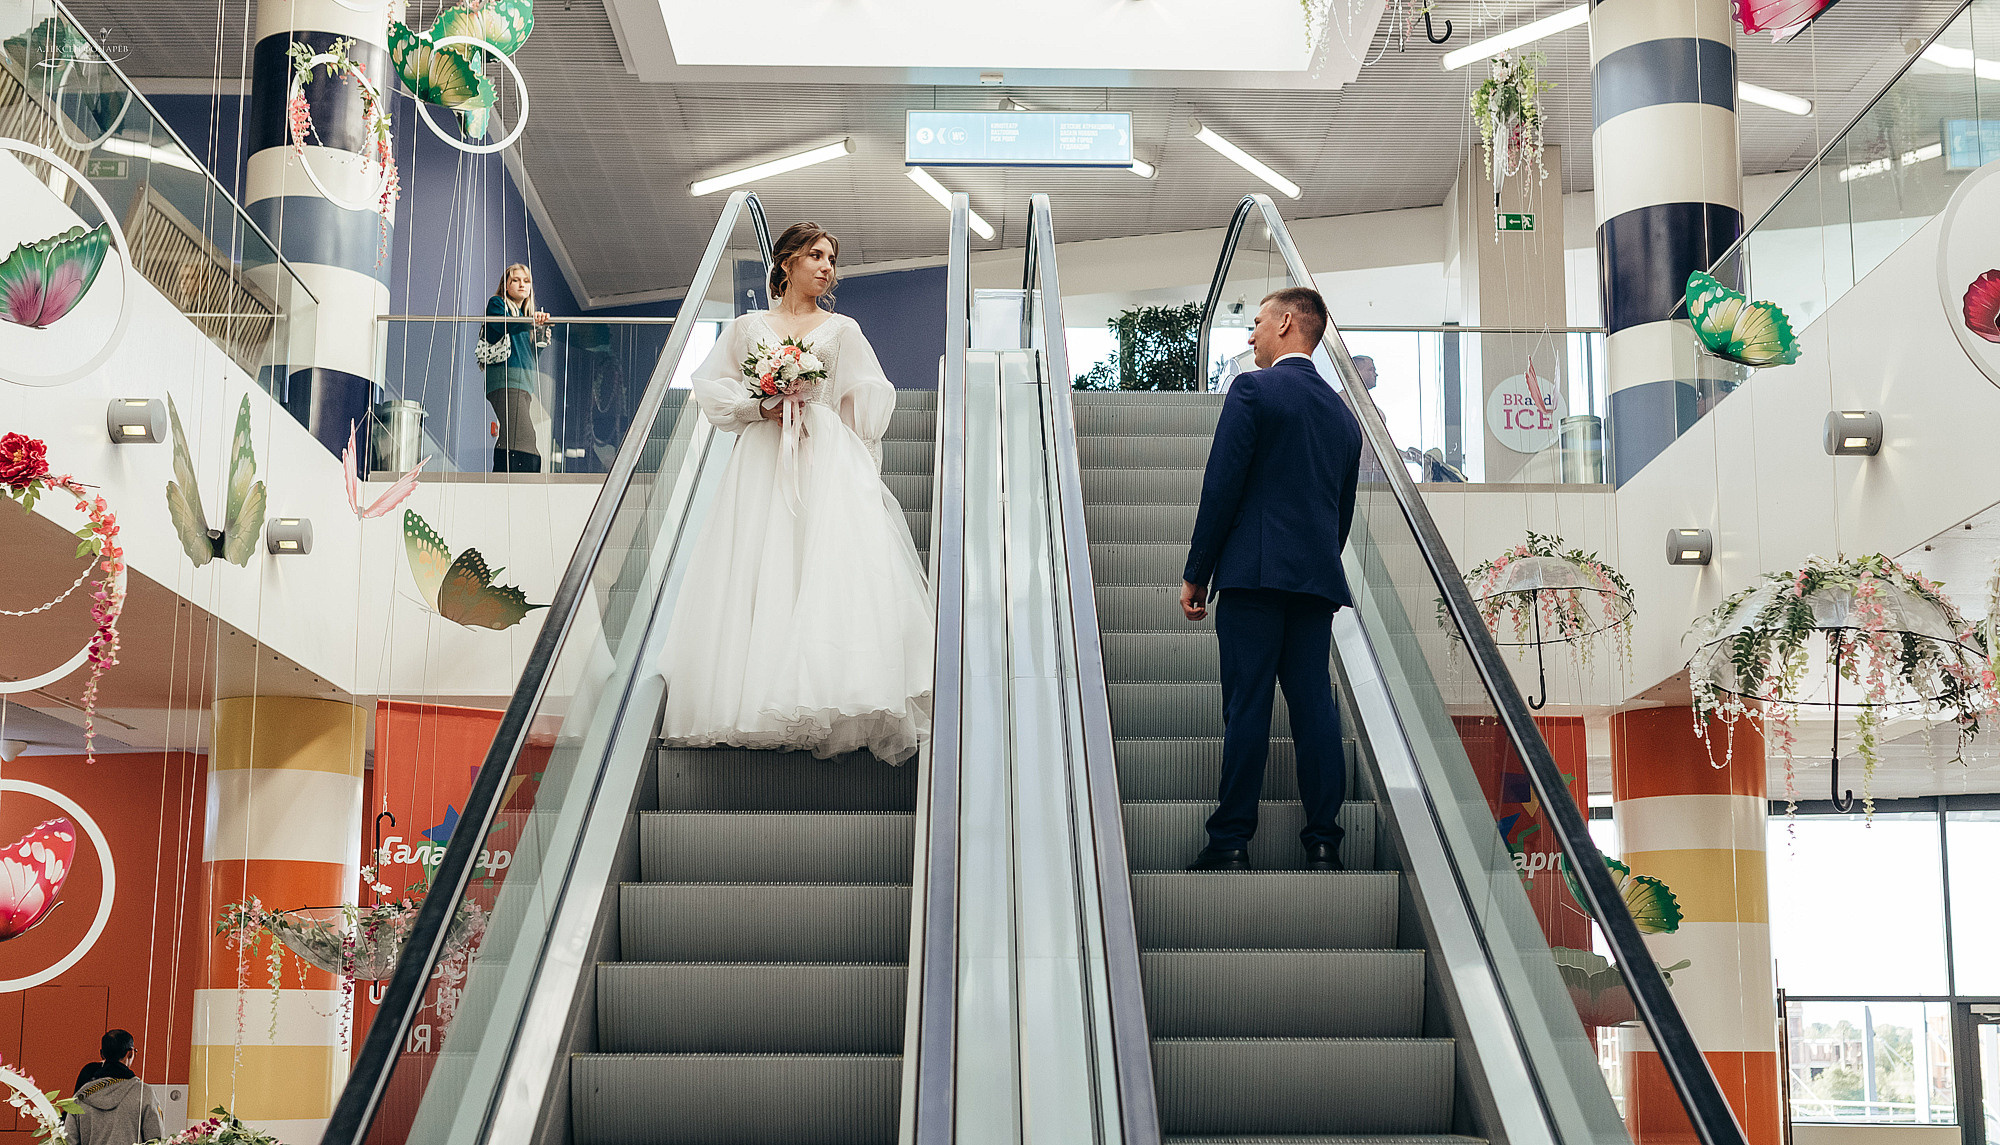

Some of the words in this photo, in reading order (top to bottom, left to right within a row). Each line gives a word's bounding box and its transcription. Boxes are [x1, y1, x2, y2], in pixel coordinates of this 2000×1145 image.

[952, 131, 965, 141] WC
[1503, 393, 1552, 406] BRad
[1503, 409, 1553, 430] ICE
